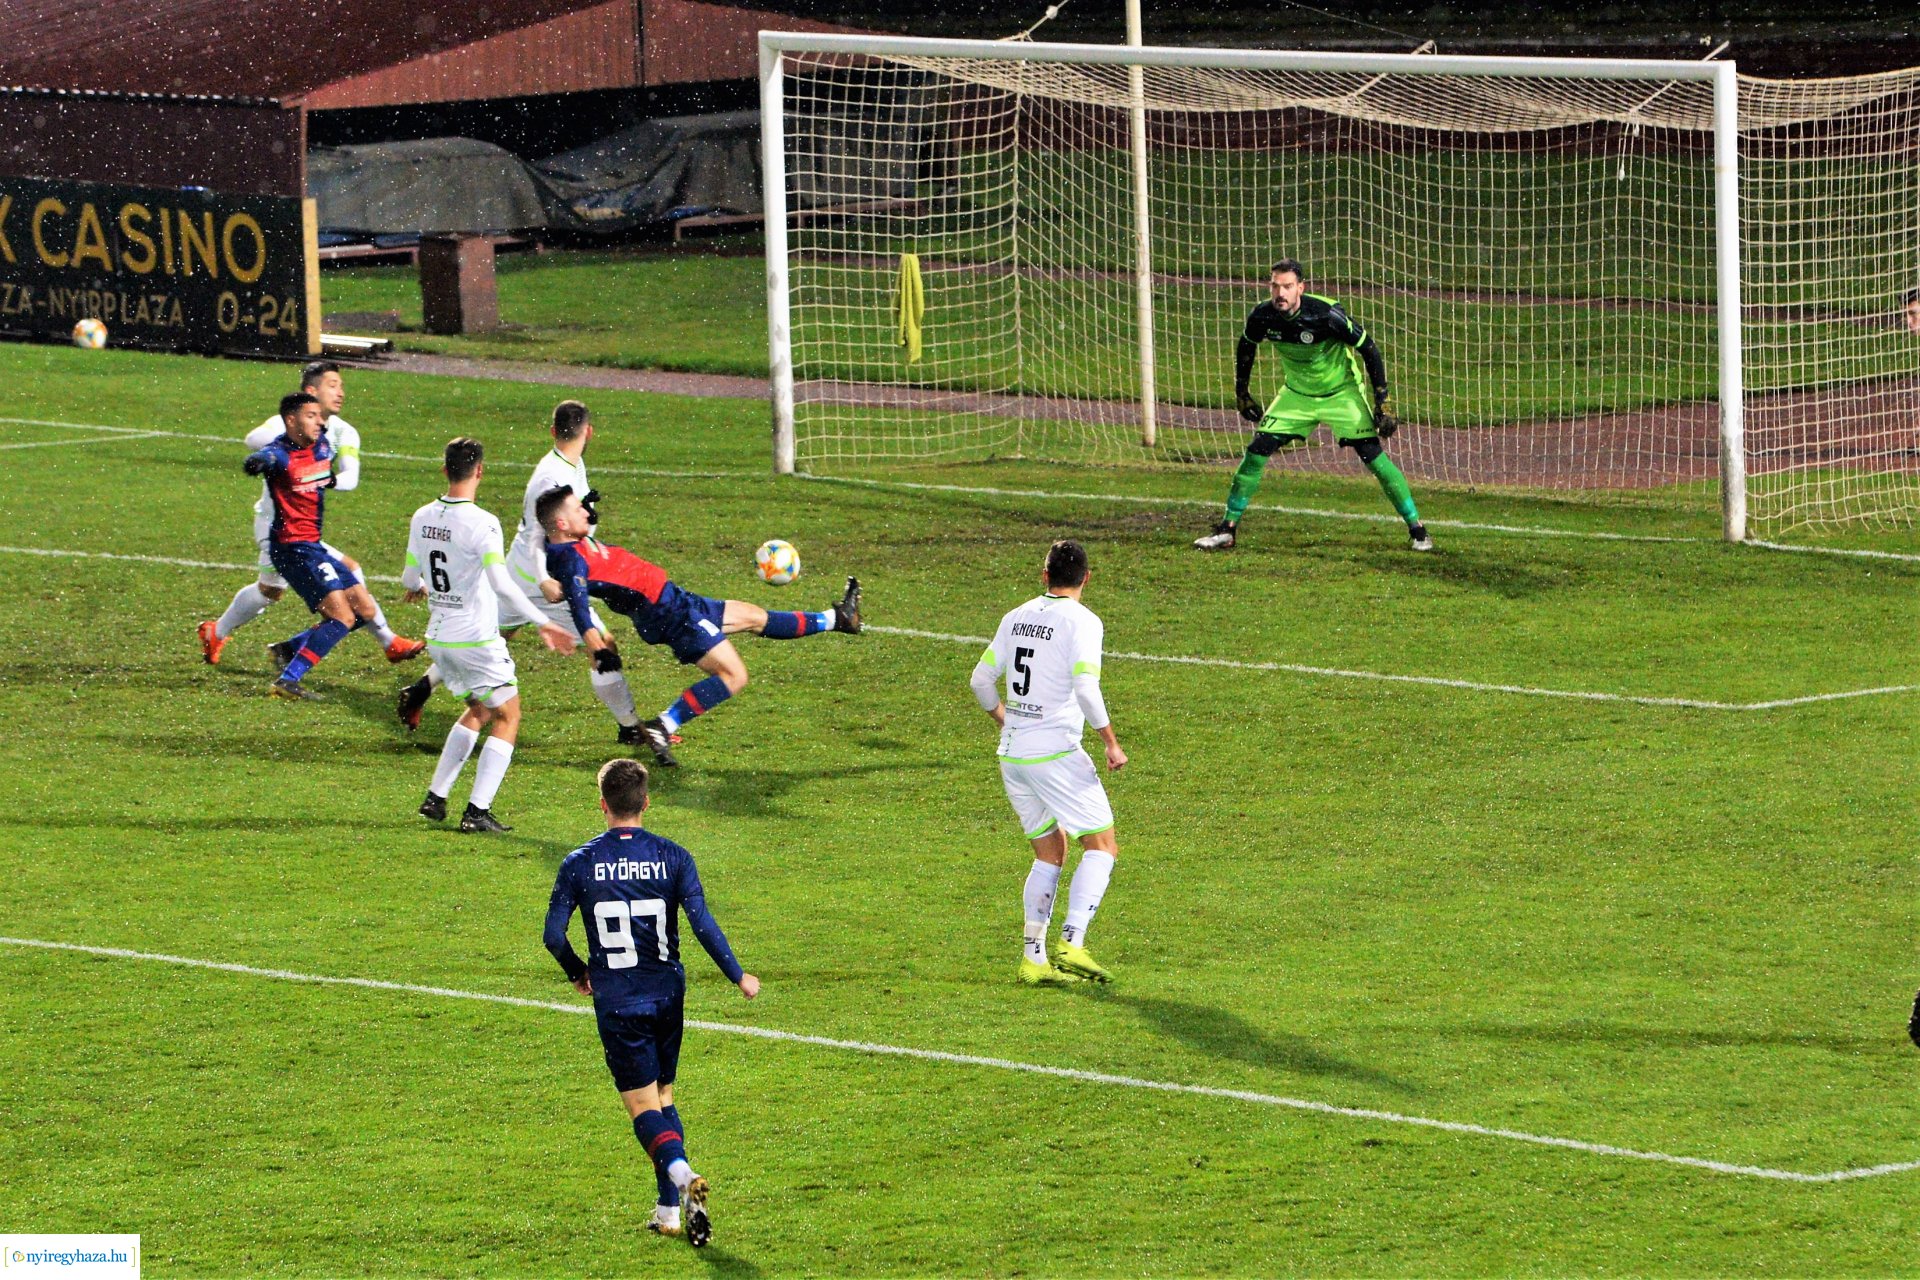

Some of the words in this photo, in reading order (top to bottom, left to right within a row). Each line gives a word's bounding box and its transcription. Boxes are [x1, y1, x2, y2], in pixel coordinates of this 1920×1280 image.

[32, 197, 266, 283] CASINO
[421, 525, 452, 543] SZEHÉR
[317, 562, 339, 581] 3
[429, 550, 451, 593] 6
[1012, 646, 1035, 697] 5
[594, 857, 668, 881] GYÖRGYI
[593, 898, 670, 970] 97
